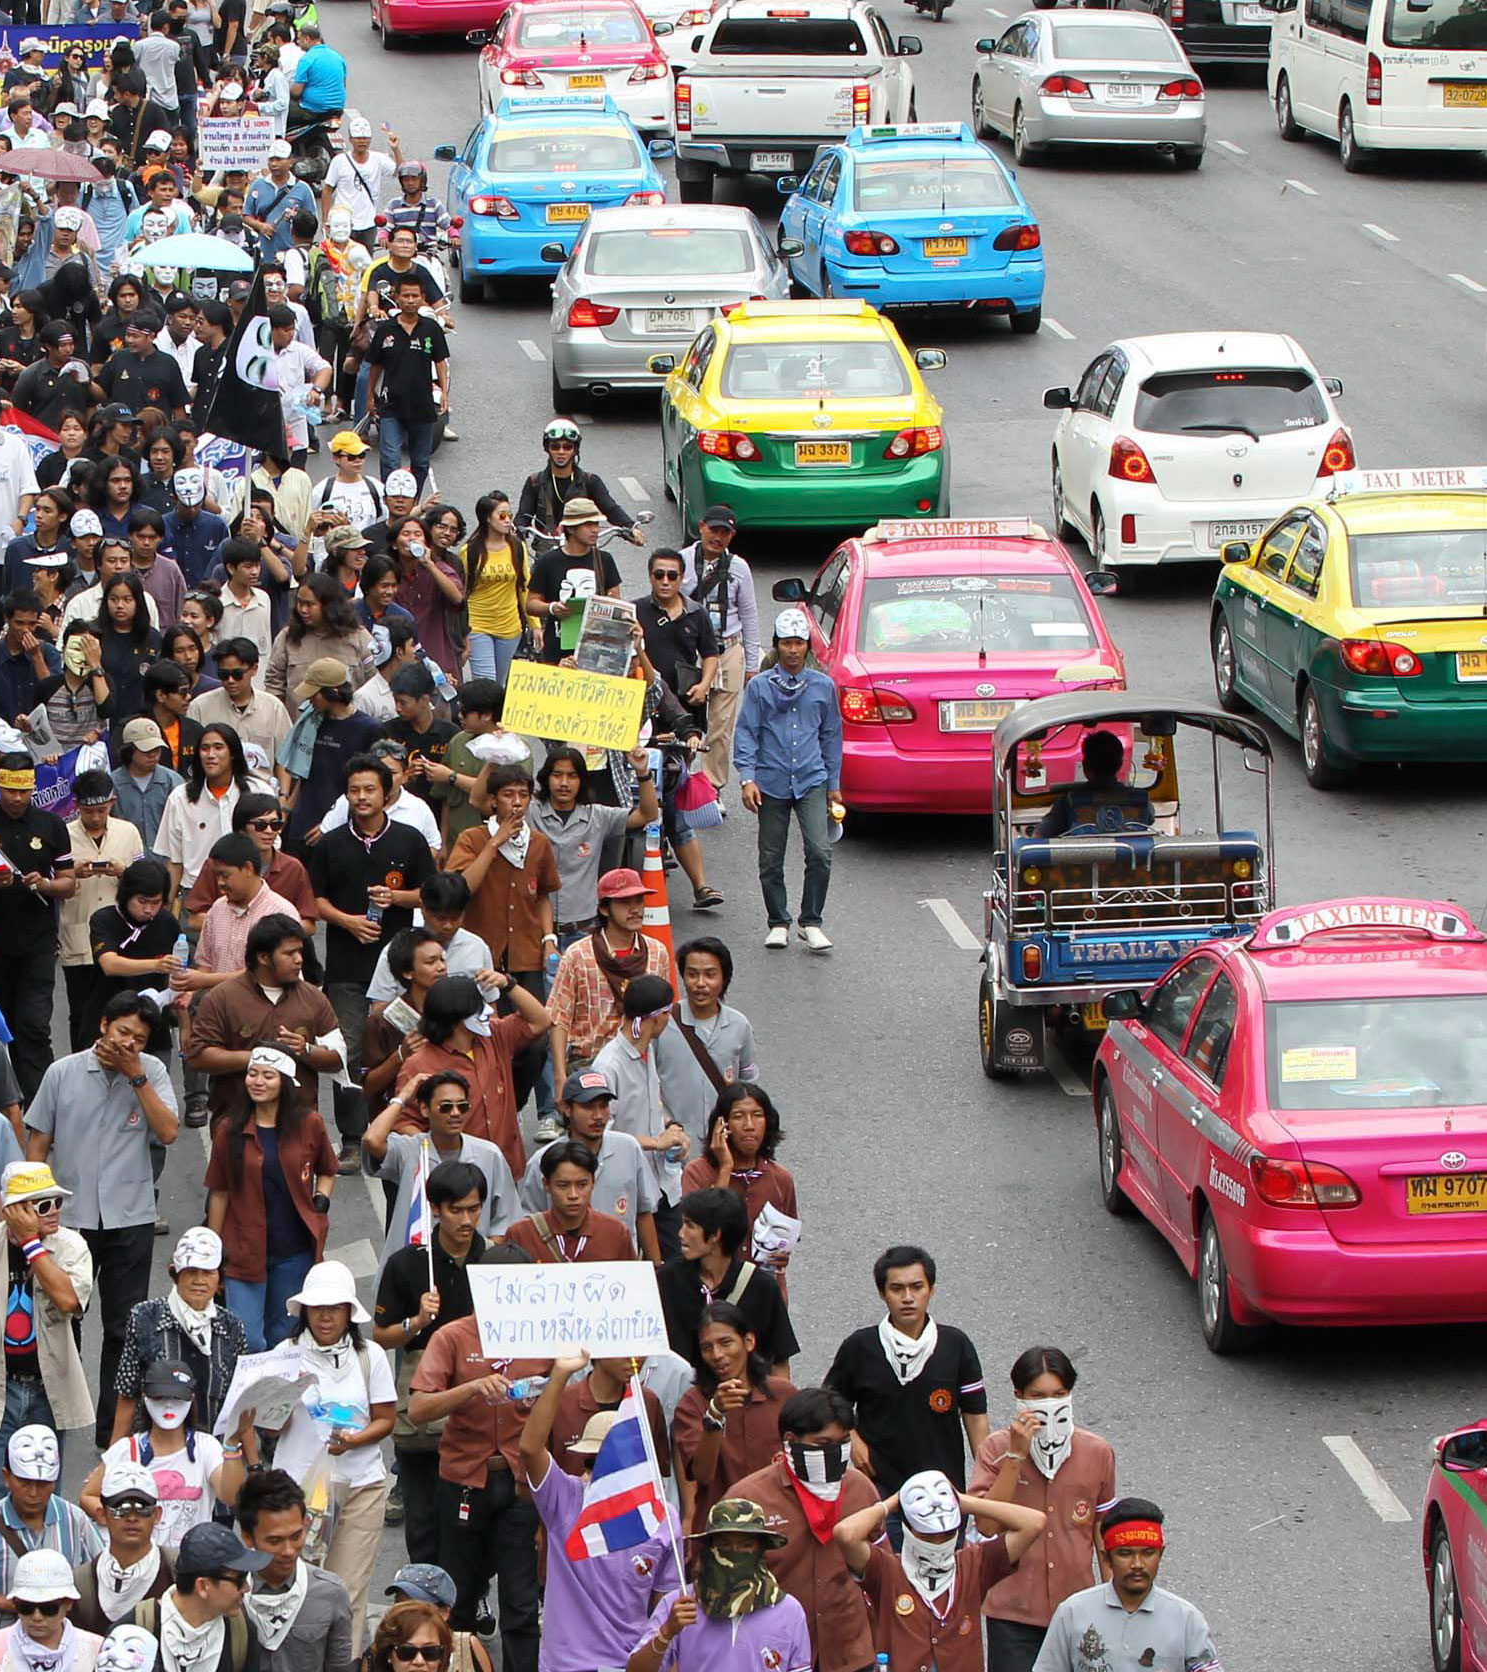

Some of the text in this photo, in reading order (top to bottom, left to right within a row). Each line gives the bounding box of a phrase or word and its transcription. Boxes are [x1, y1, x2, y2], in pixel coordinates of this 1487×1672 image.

[1447, 89, 1487, 101] 32-0729
[820, 444, 848, 455] 3373
[1363, 470, 1467, 488] TAXI METER
[1239, 524, 1265, 535] 9157
[1069, 938, 1200, 963] THAILAN
[1444, 1174, 1487, 1197] 9707
[1420, 1199, 1480, 1210] กรุงเทพมหานคร
